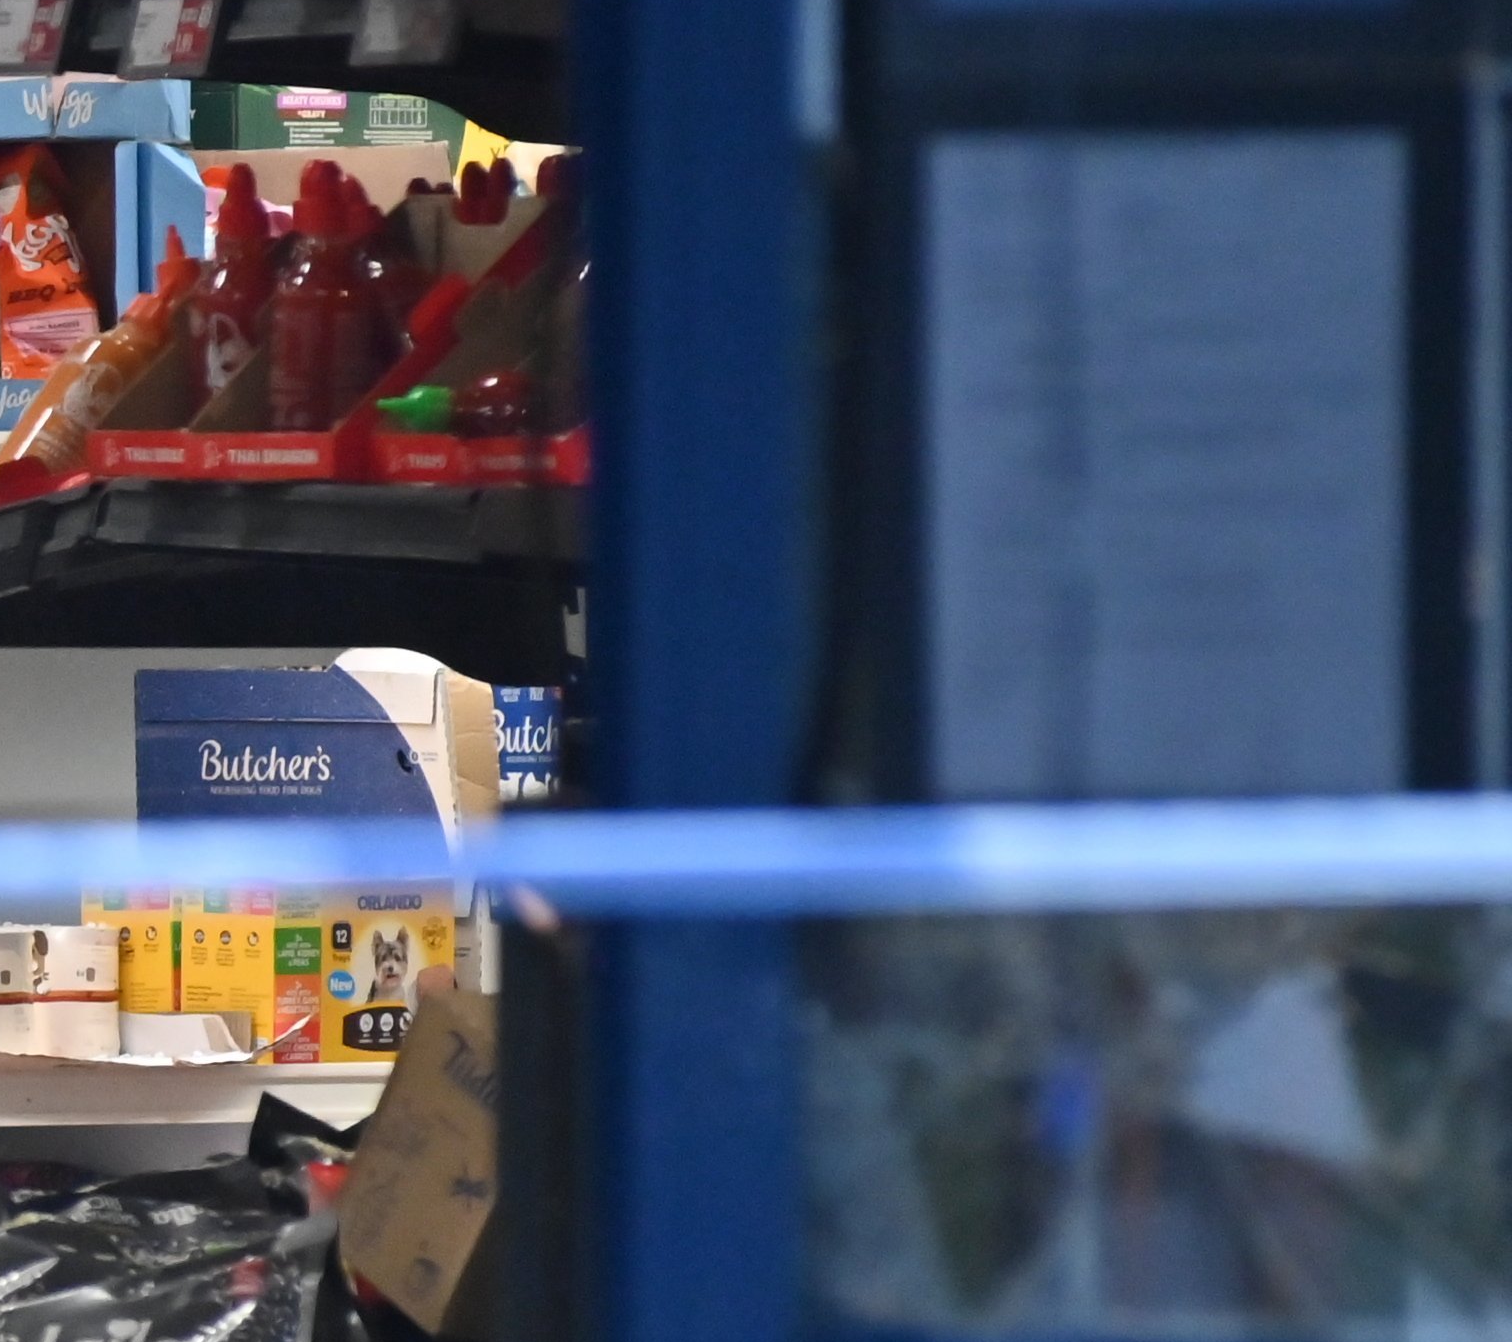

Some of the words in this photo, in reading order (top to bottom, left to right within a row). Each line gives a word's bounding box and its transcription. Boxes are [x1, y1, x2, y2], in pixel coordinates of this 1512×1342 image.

[198, 739, 332, 782] Butcher's
[282, 785, 298, 795] FOR
[357, 894, 423, 911] ORLANDO
[335, 929, 348, 944] 12
[330, 978, 354, 992] New
